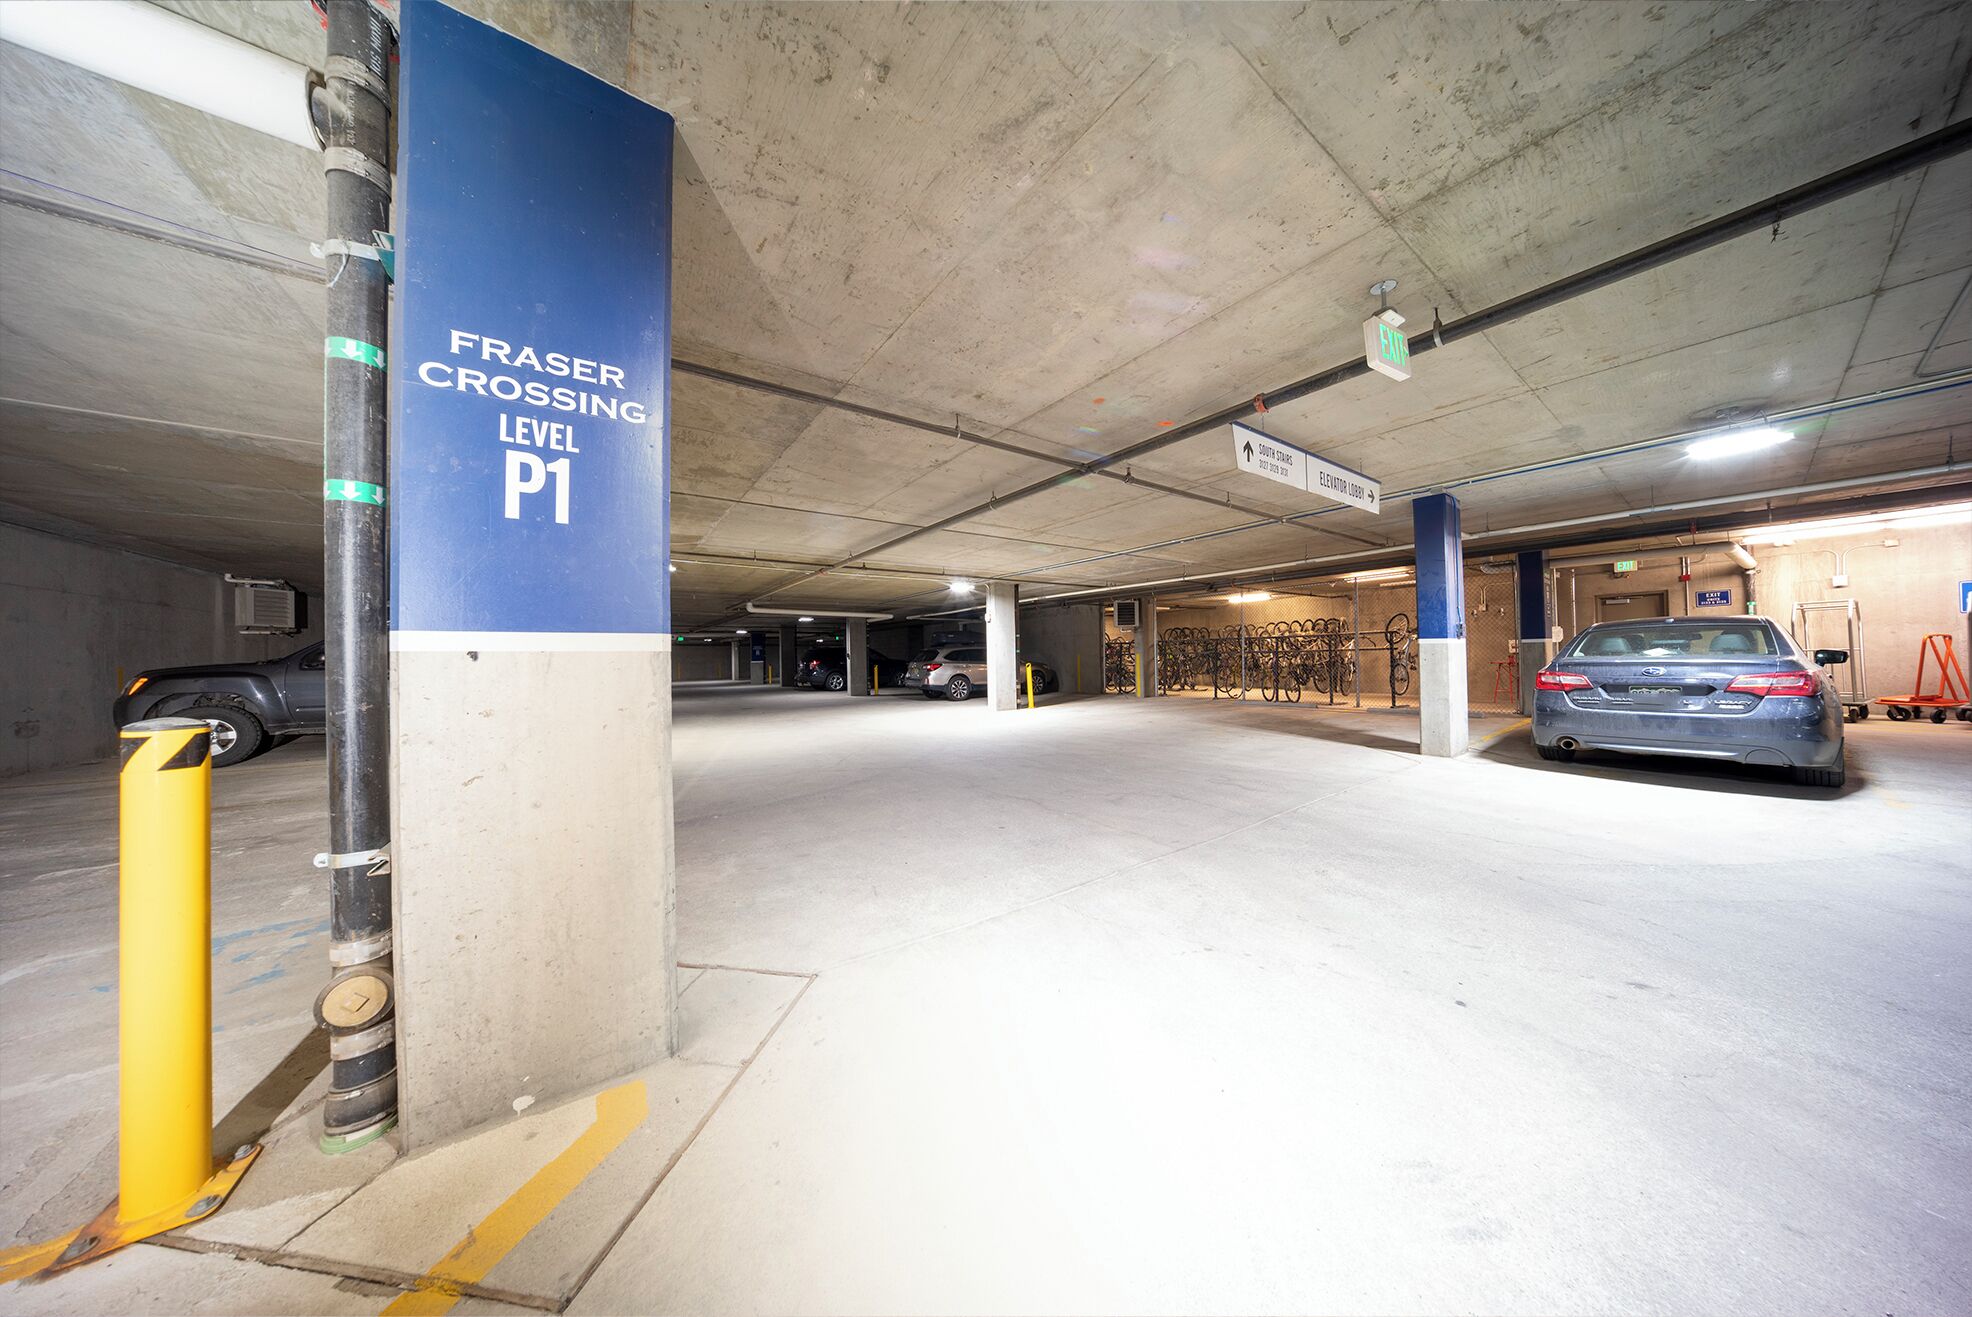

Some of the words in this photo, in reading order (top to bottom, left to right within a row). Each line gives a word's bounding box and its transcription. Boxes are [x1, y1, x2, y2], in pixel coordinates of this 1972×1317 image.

[450, 328, 625, 390] FRASER
[1379, 323, 1406, 367] EXIT
[418, 361, 647, 424] CROSSING
[499, 413, 580, 453] LEVEL
[1259, 443, 1276, 460] SOUTH
[1276, 450, 1294, 467] STAIRS
[504, 449, 570, 525] P1
[1319, 470, 1347, 495] ELEVATOR
[1348, 481, 1365, 500] LOBBY
[1617, 560, 1634, 571] EXIT
